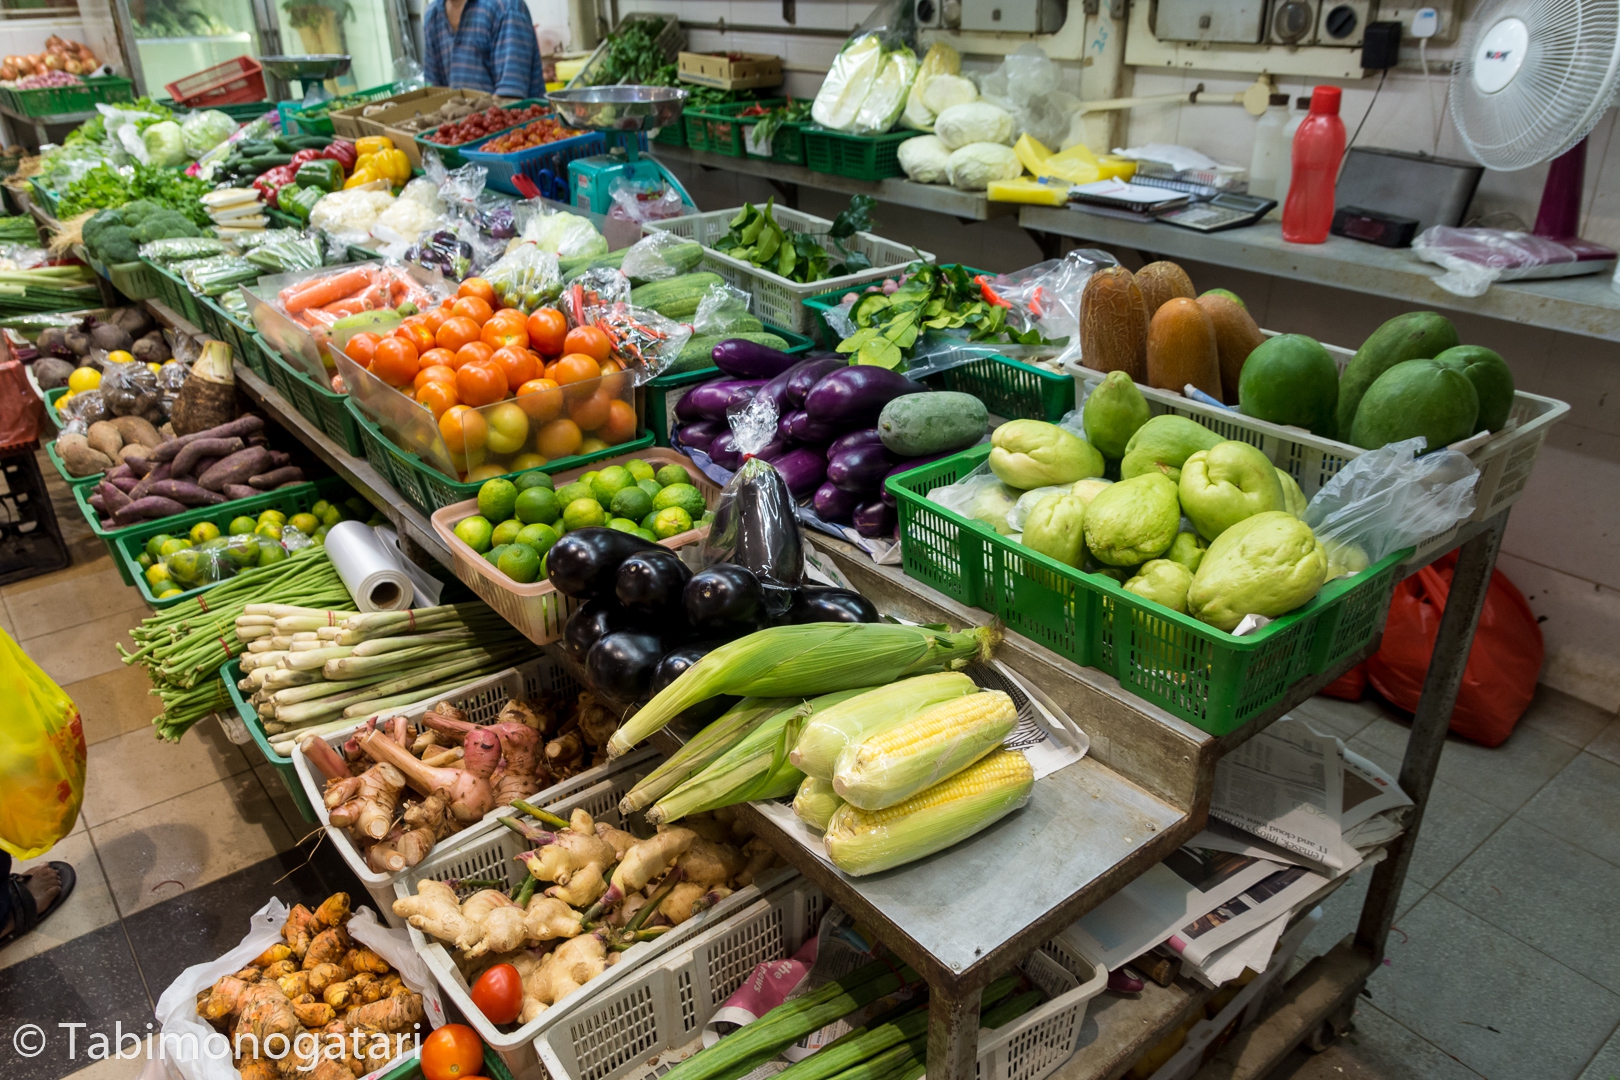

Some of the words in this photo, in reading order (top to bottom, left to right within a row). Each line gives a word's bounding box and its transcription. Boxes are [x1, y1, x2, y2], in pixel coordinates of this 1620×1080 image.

[1247, 817, 1267, 829] joint
[1246, 825, 1279, 844] Infosys
[1269, 826, 1296, 840] cloud
[1297, 836, 1316, 847] and
[1316, 845, 1328, 854] IT
[774, 961, 793, 979] the
[753, 966, 768, 993] news
